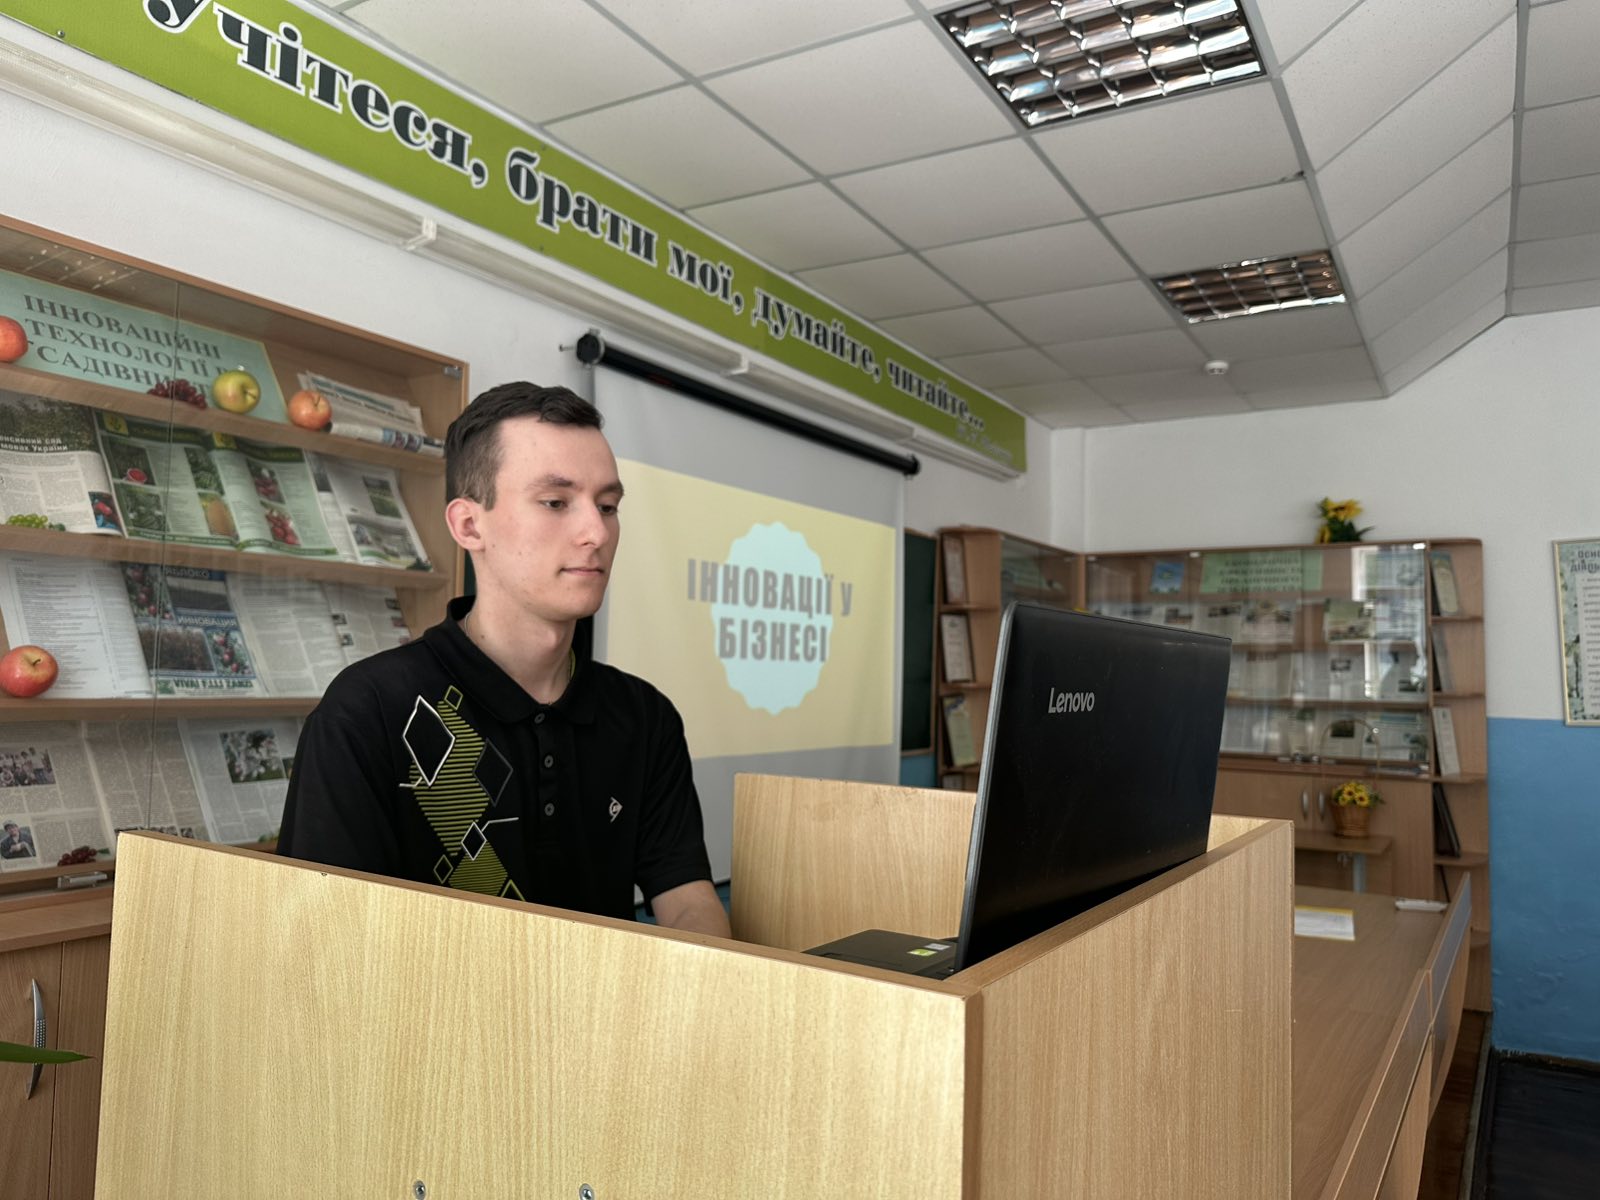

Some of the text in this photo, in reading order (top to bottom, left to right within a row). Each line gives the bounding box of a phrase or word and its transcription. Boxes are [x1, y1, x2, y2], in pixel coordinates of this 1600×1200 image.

[505, 147, 657, 267] брати
[668, 241, 743, 314] мої,
[752, 287, 881, 383] думайте,
[24, 294, 221, 360] ІННОВАЦІЙНІ
[25, 318, 209, 378] ТЕХНОЛОГІЇ
[687, 558, 834, 619] ІННОВАЦІЇ
[719, 616, 827, 663] БІЗНЕСІ
[1048, 687, 1095, 713] Lenovo
